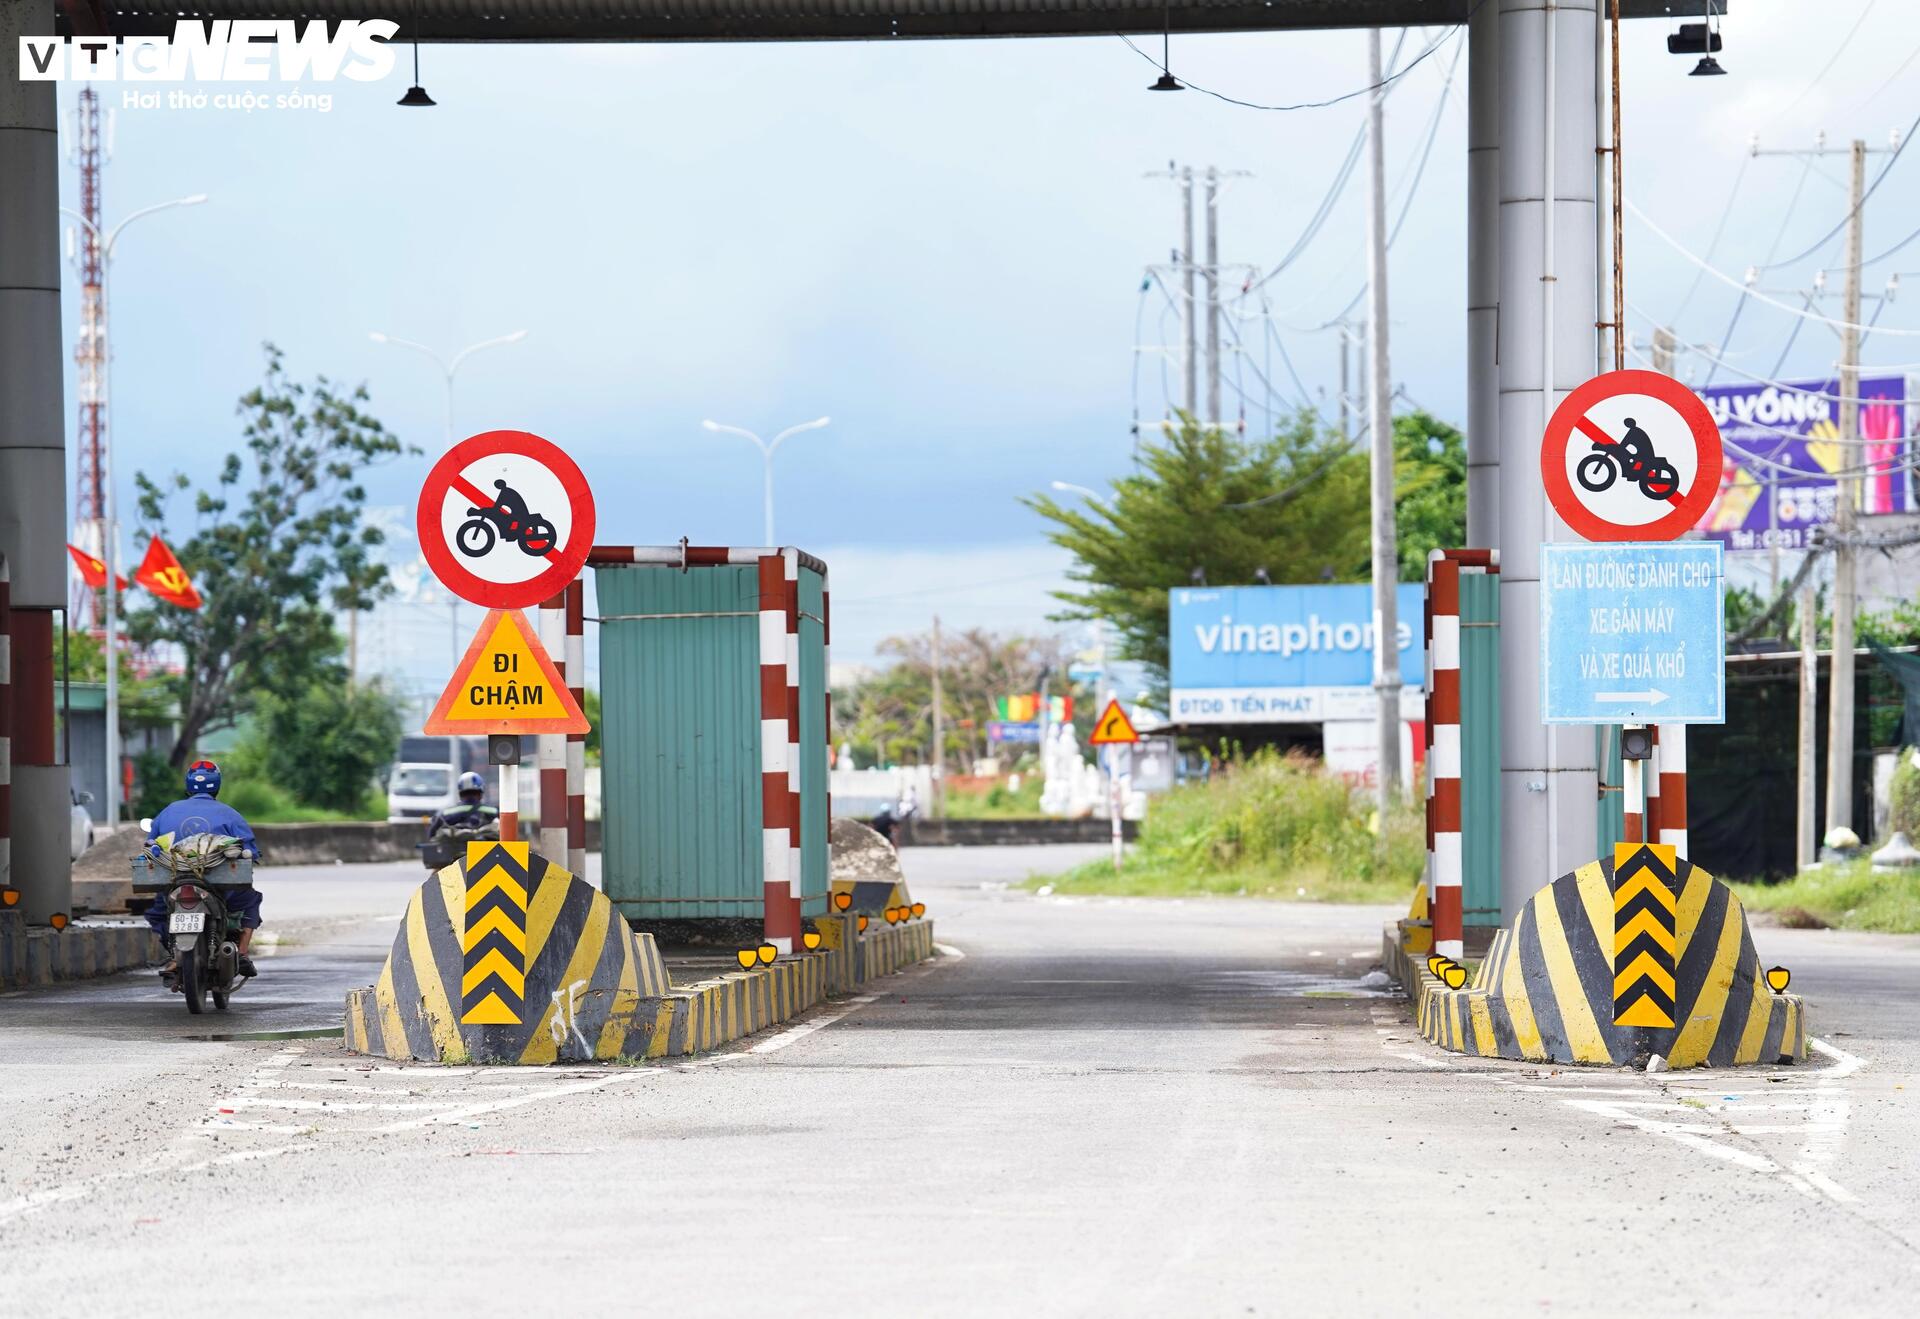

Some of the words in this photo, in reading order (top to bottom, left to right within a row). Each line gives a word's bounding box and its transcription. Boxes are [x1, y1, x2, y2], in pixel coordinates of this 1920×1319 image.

[1553, 556, 1582, 590] LÀN
[1586, 555, 1636, 590] ĐƯỜNG
[1639, 554, 1679, 588] DÀNH
[1682, 561, 1711, 588] CHO
[1590, 607, 1609, 634] XE
[1611, 595, 1641, 634] GẮN
[1645, 600, 1675, 633] MÁY
[493, 653, 518, 673] ĐI
[1580, 646, 1600, 679] VÀ
[1602, 653, 1620, 679] XE
[1623, 646, 1652, 679] QUÁ
[1655, 640, 1687, 679] KHỔ
[470, 680, 543, 710] CHẬM
[175, 922, 199, 931] 3289
